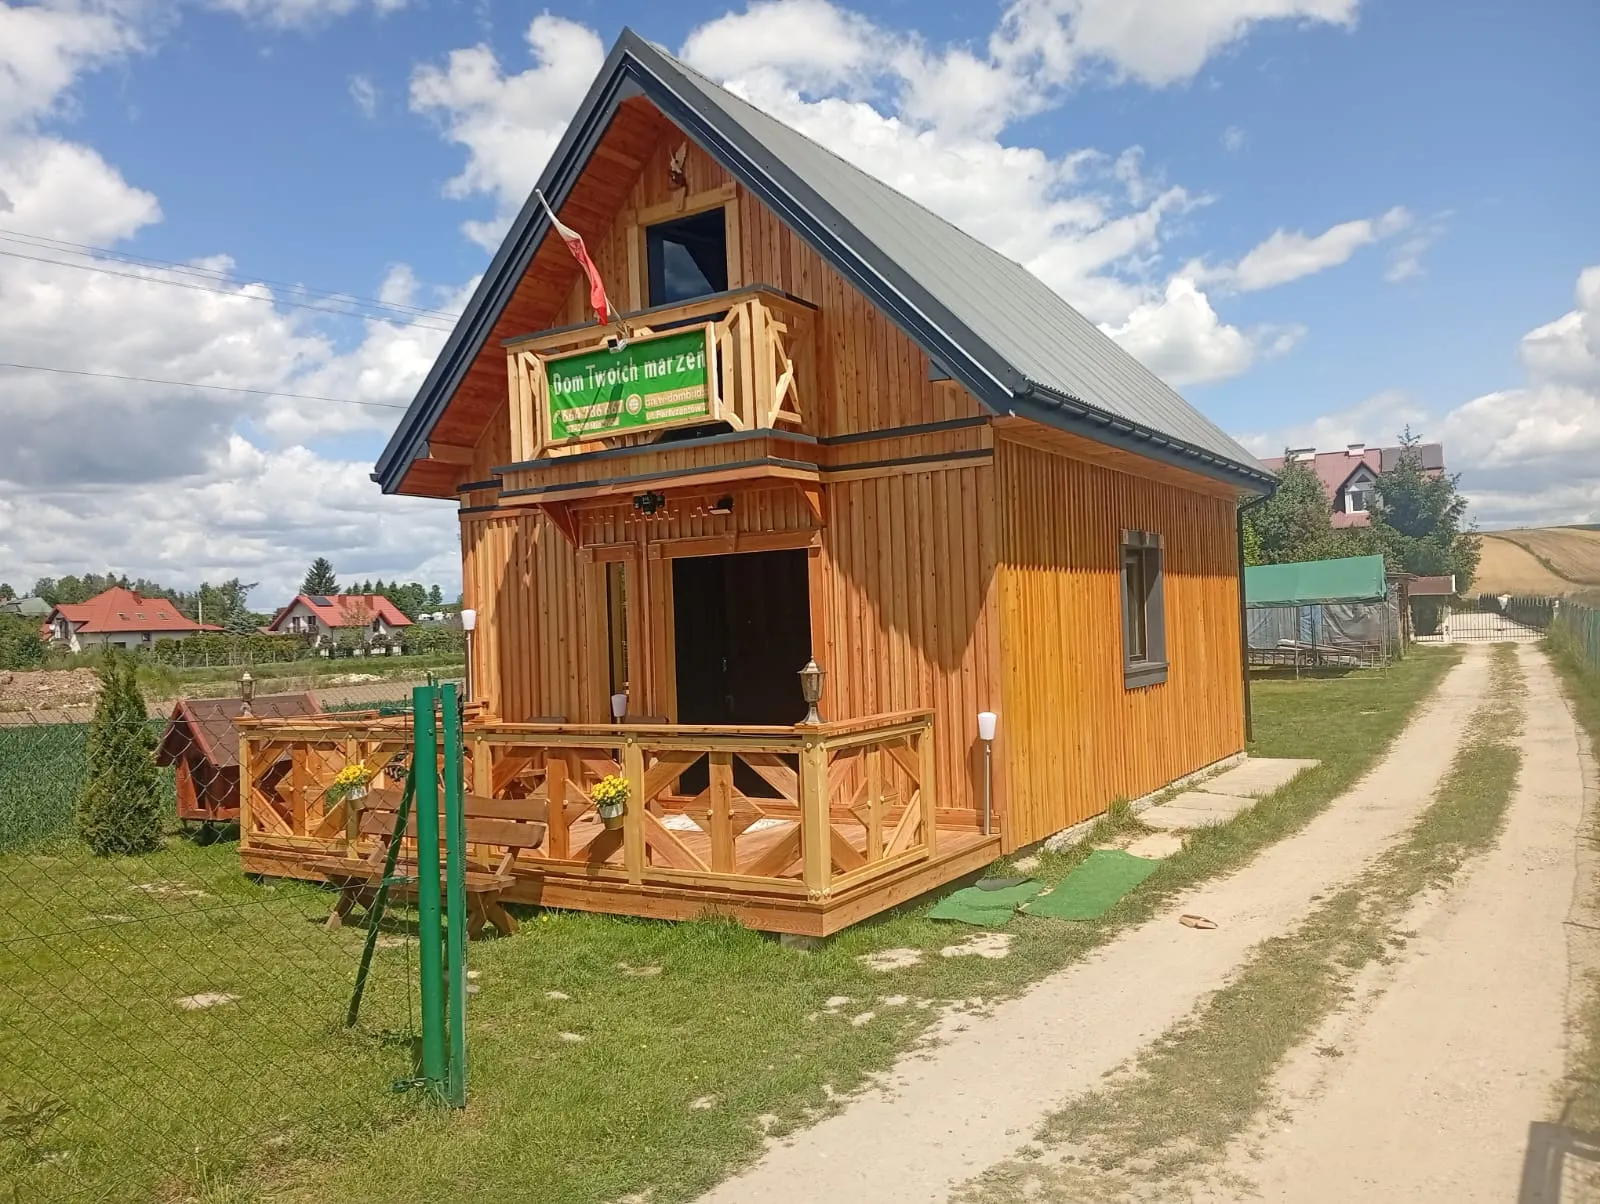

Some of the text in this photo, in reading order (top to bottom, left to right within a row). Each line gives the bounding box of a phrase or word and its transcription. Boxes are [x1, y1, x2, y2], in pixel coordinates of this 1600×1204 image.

[553, 342, 706, 395] Dom Twoich marzeń
